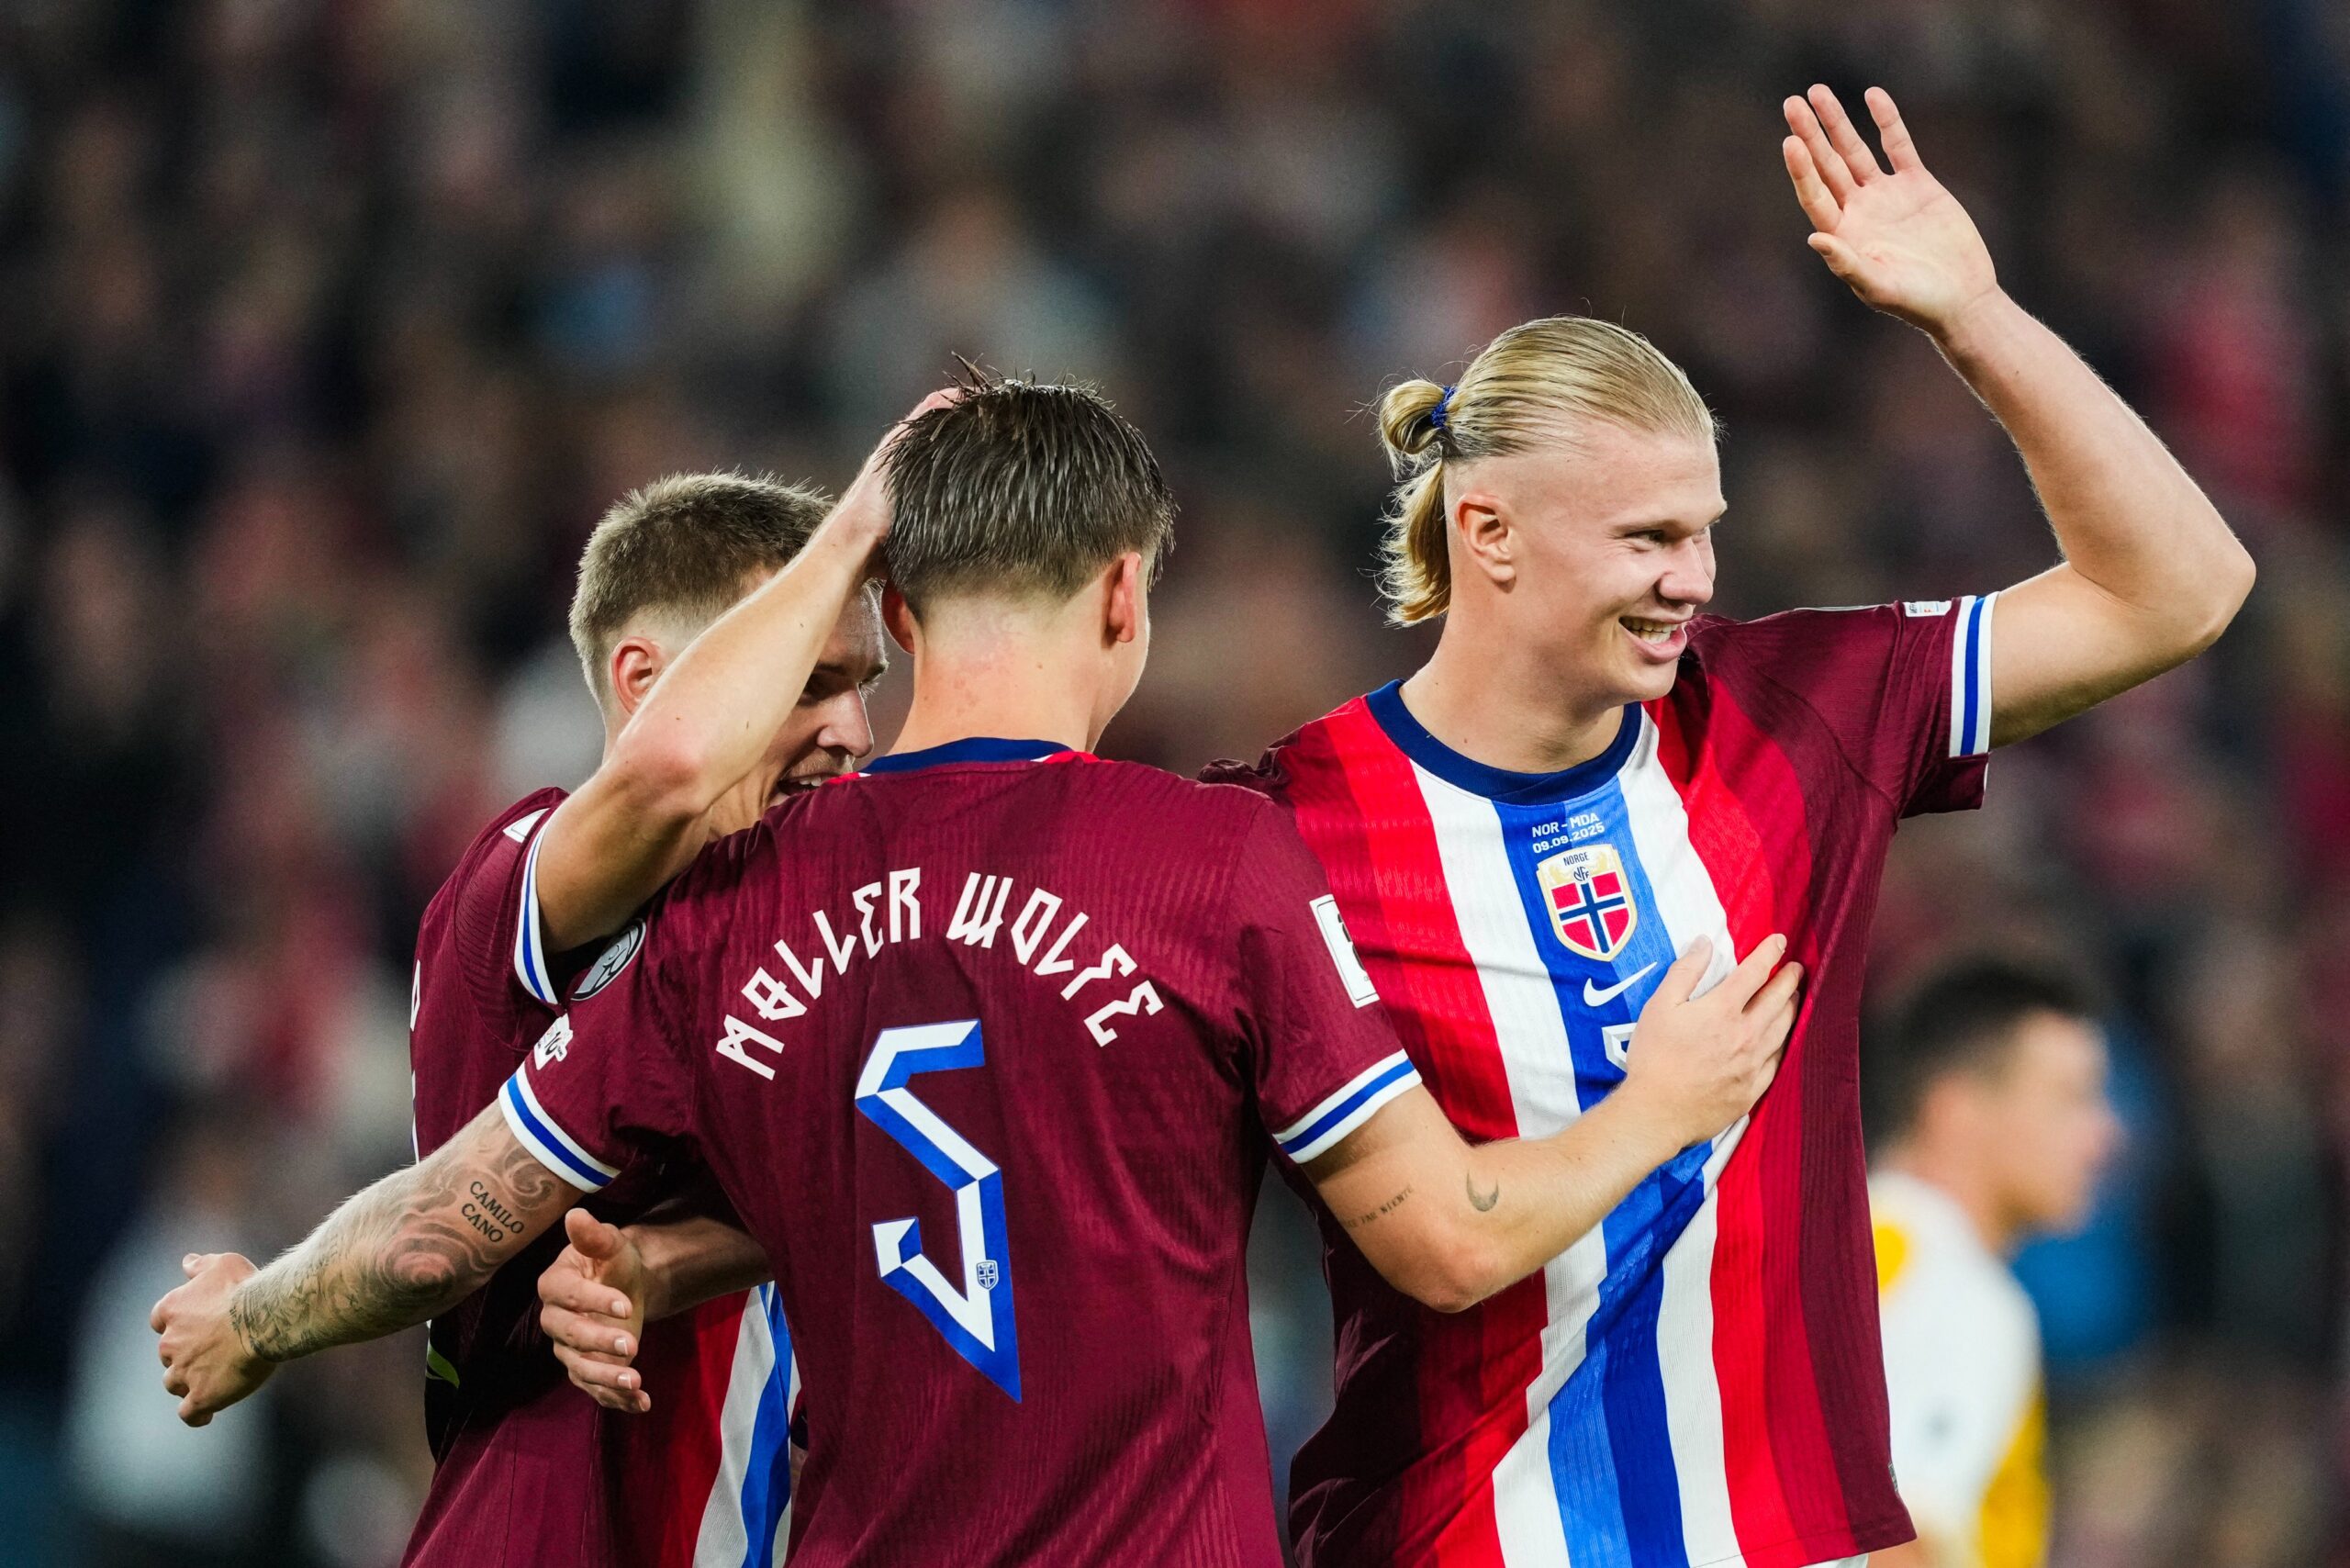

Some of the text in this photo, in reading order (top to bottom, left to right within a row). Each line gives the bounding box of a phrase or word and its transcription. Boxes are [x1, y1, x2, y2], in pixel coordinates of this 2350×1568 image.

[1531, 822, 1560, 837] NOR
[1569, 812, 1599, 828] MDA
[1532, 822, 1605, 853] 09.09.2025
[1562, 852, 1589, 866] NORGE
[716, 867, 1165, 1081] MØLLER WOLFE
[461, 1203, 504, 1243] CANO
[469, 1181, 525, 1234] CAMILO
[854, 1018, 1022, 1404] 5
